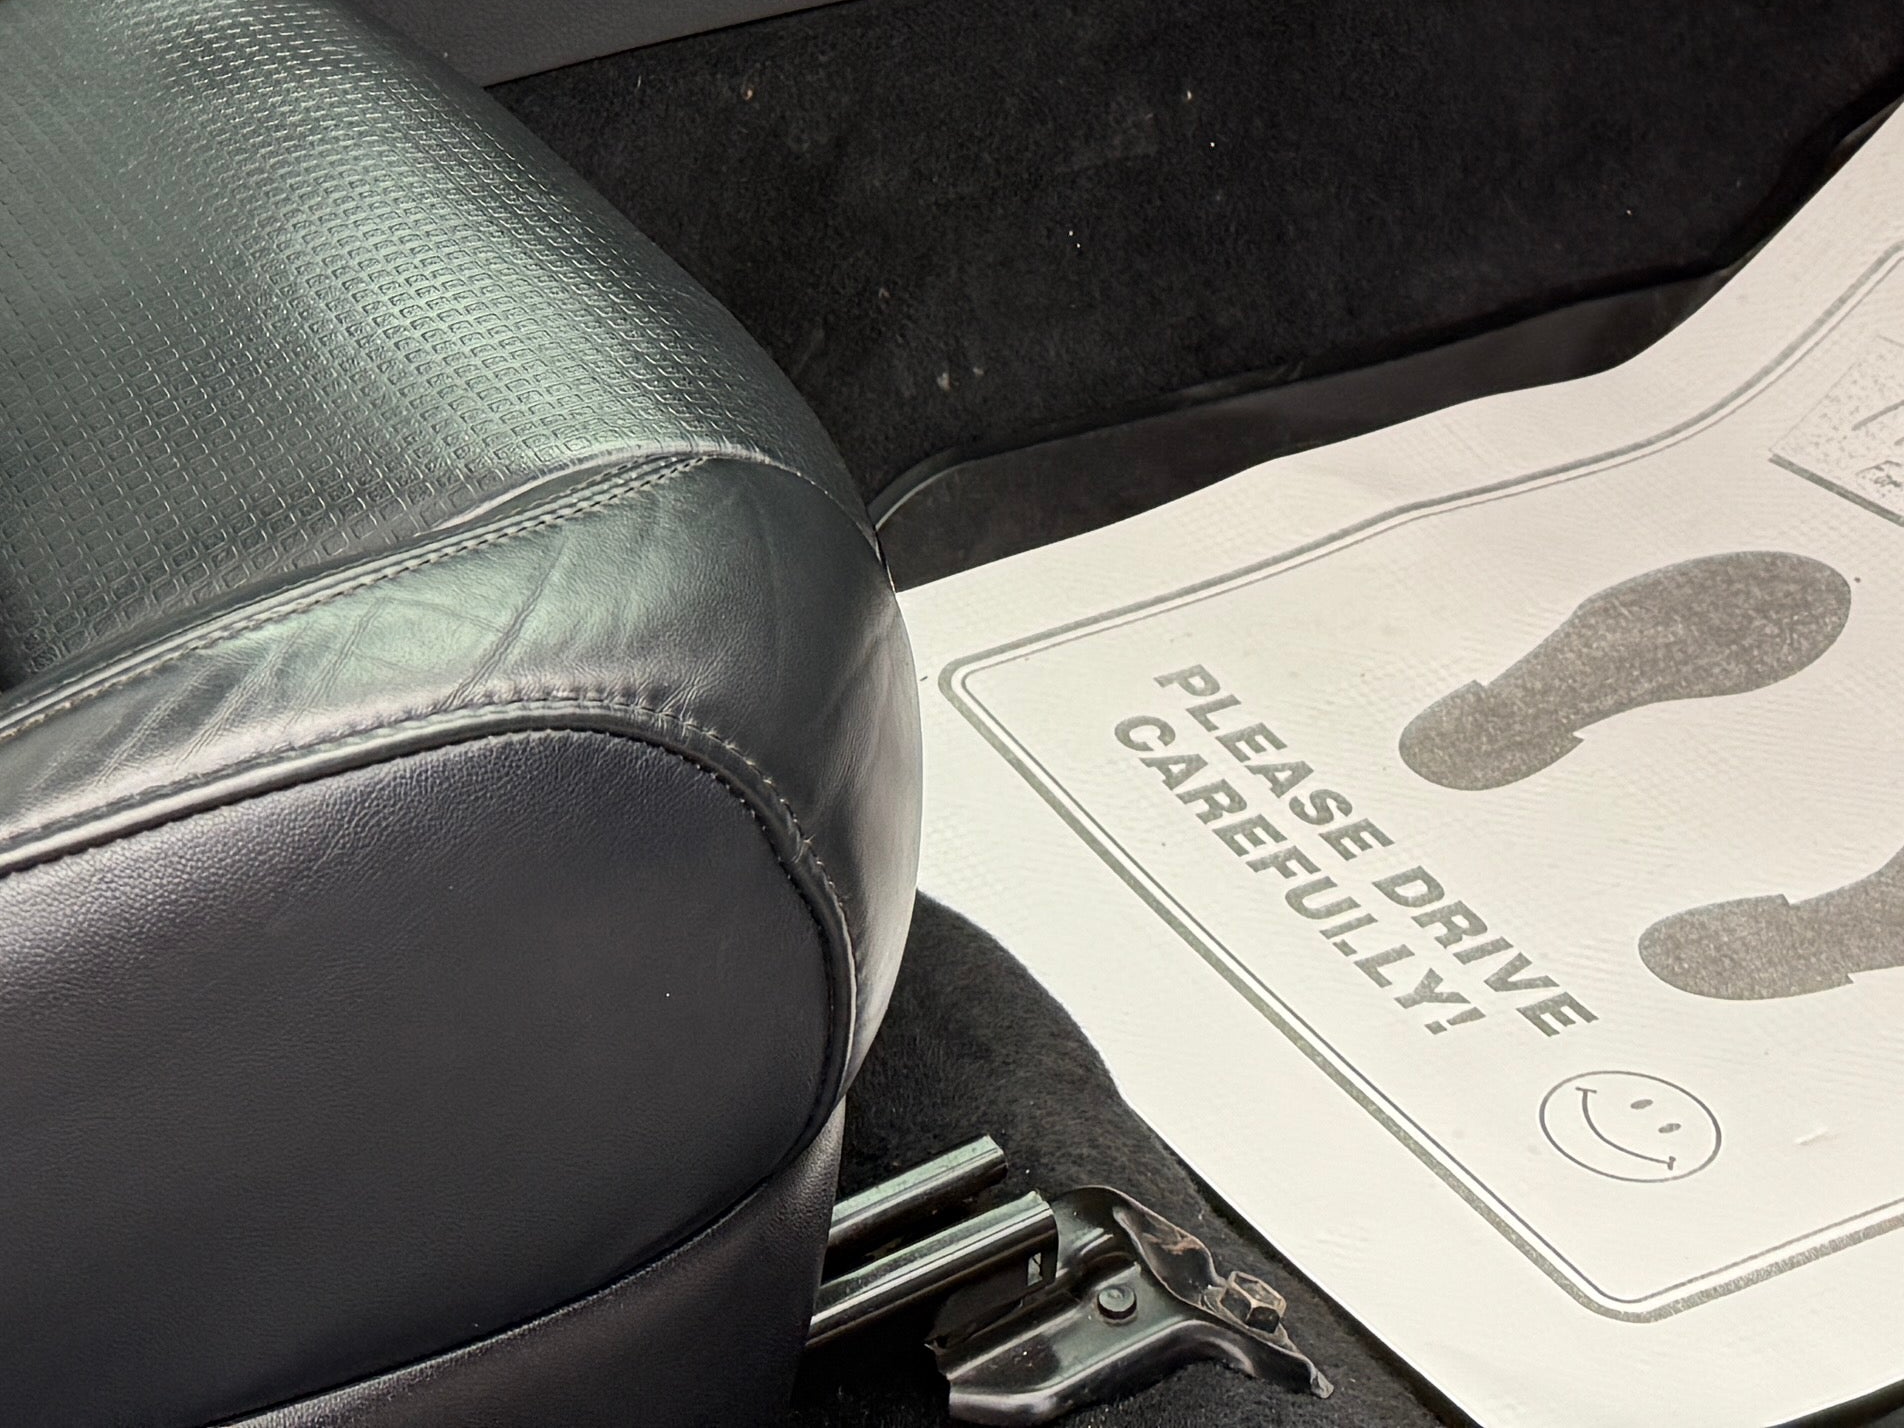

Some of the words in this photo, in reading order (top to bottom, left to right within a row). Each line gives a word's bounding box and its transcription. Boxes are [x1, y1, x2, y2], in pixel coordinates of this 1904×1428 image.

[1114, 715, 1487, 1035] CAREFULLY!
[1152, 663, 1396, 861] PLEASE
[1371, 864, 1600, 1038] DRIVE
